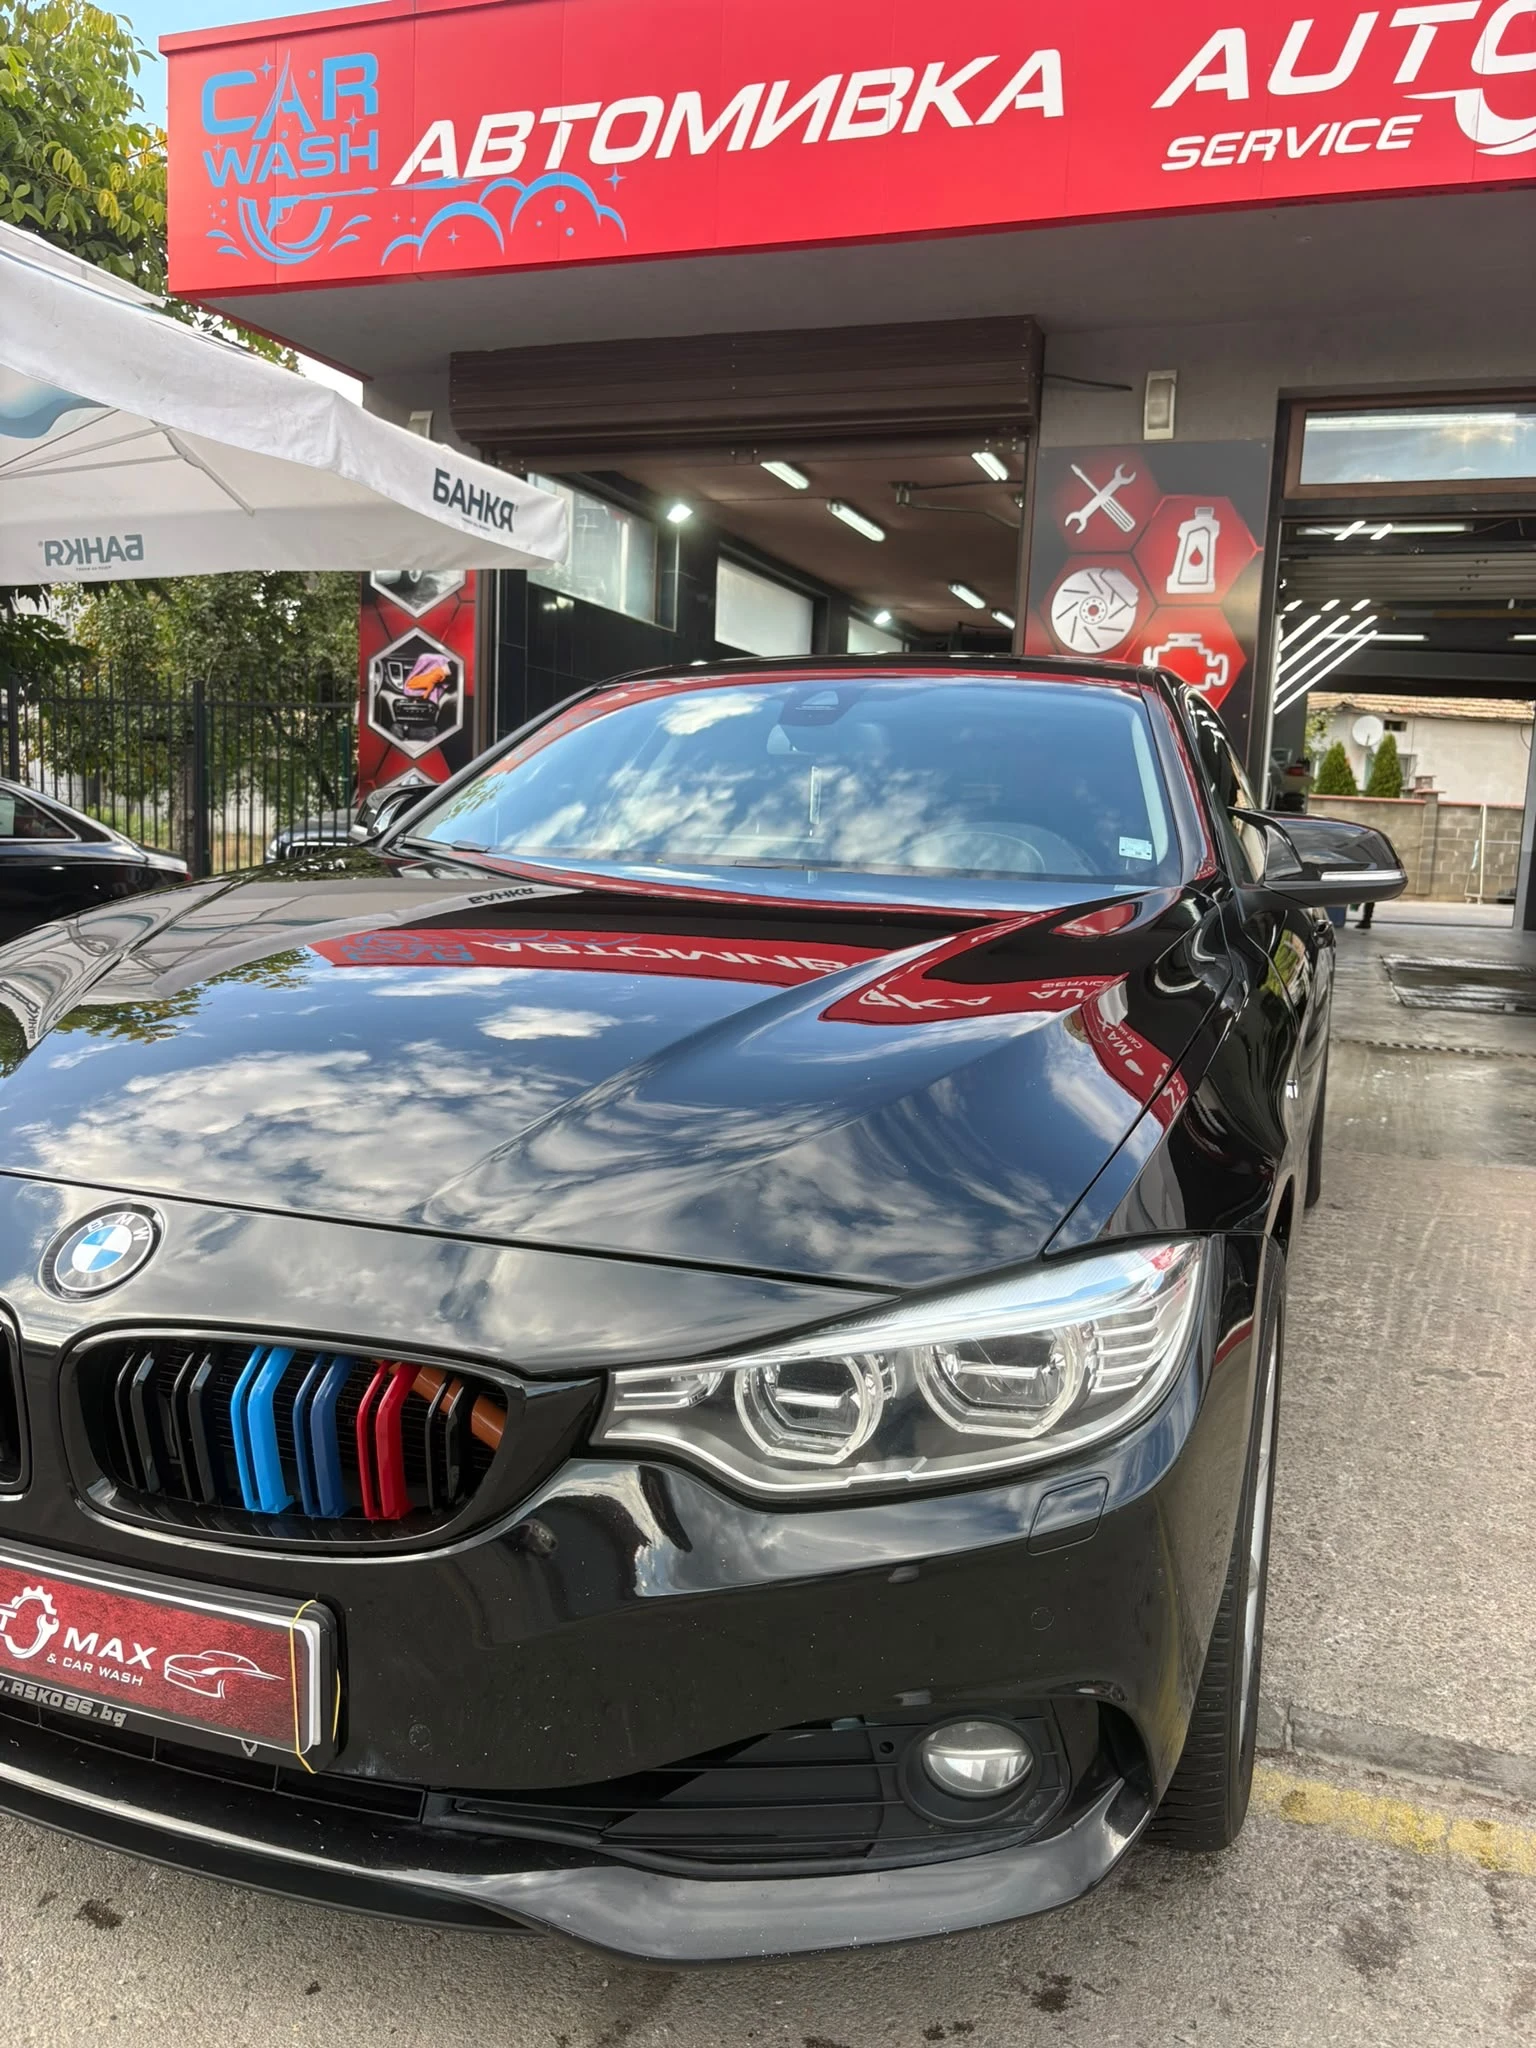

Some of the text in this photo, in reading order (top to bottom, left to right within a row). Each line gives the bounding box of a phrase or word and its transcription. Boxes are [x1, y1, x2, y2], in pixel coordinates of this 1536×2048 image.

[202, 51, 378, 140] CAR
[391, 49, 1064, 186] АВТОМИВКА
[202, 130, 379, 187] WASH
[1161, 114, 1423, 171] SERVICE
[433, 467, 515, 533] БАНКЯ
[46, 1653, 144, 1687] & CAR WASH
[63, 1627, 157, 1670] MAX
